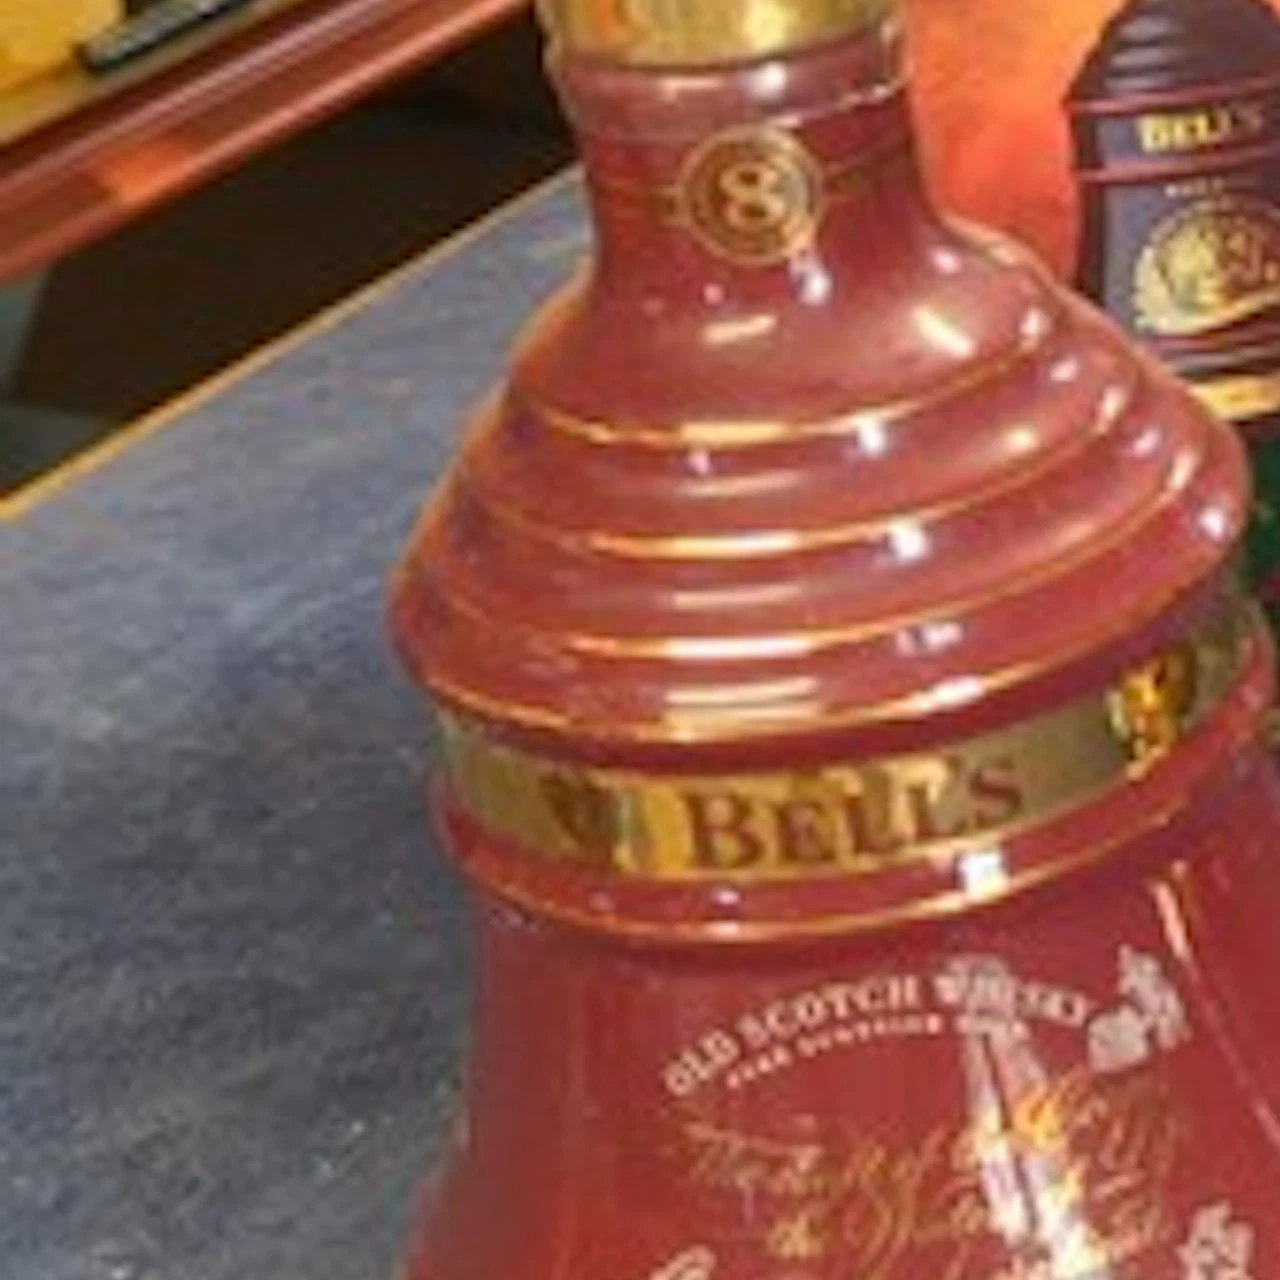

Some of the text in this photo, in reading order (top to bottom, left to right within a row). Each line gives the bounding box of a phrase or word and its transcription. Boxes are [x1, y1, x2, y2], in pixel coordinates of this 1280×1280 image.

[720, 161, 786, 231] 8
[663, 1028, 739, 1097] OLD
[736, 975, 919, 1050] SCOTCH
